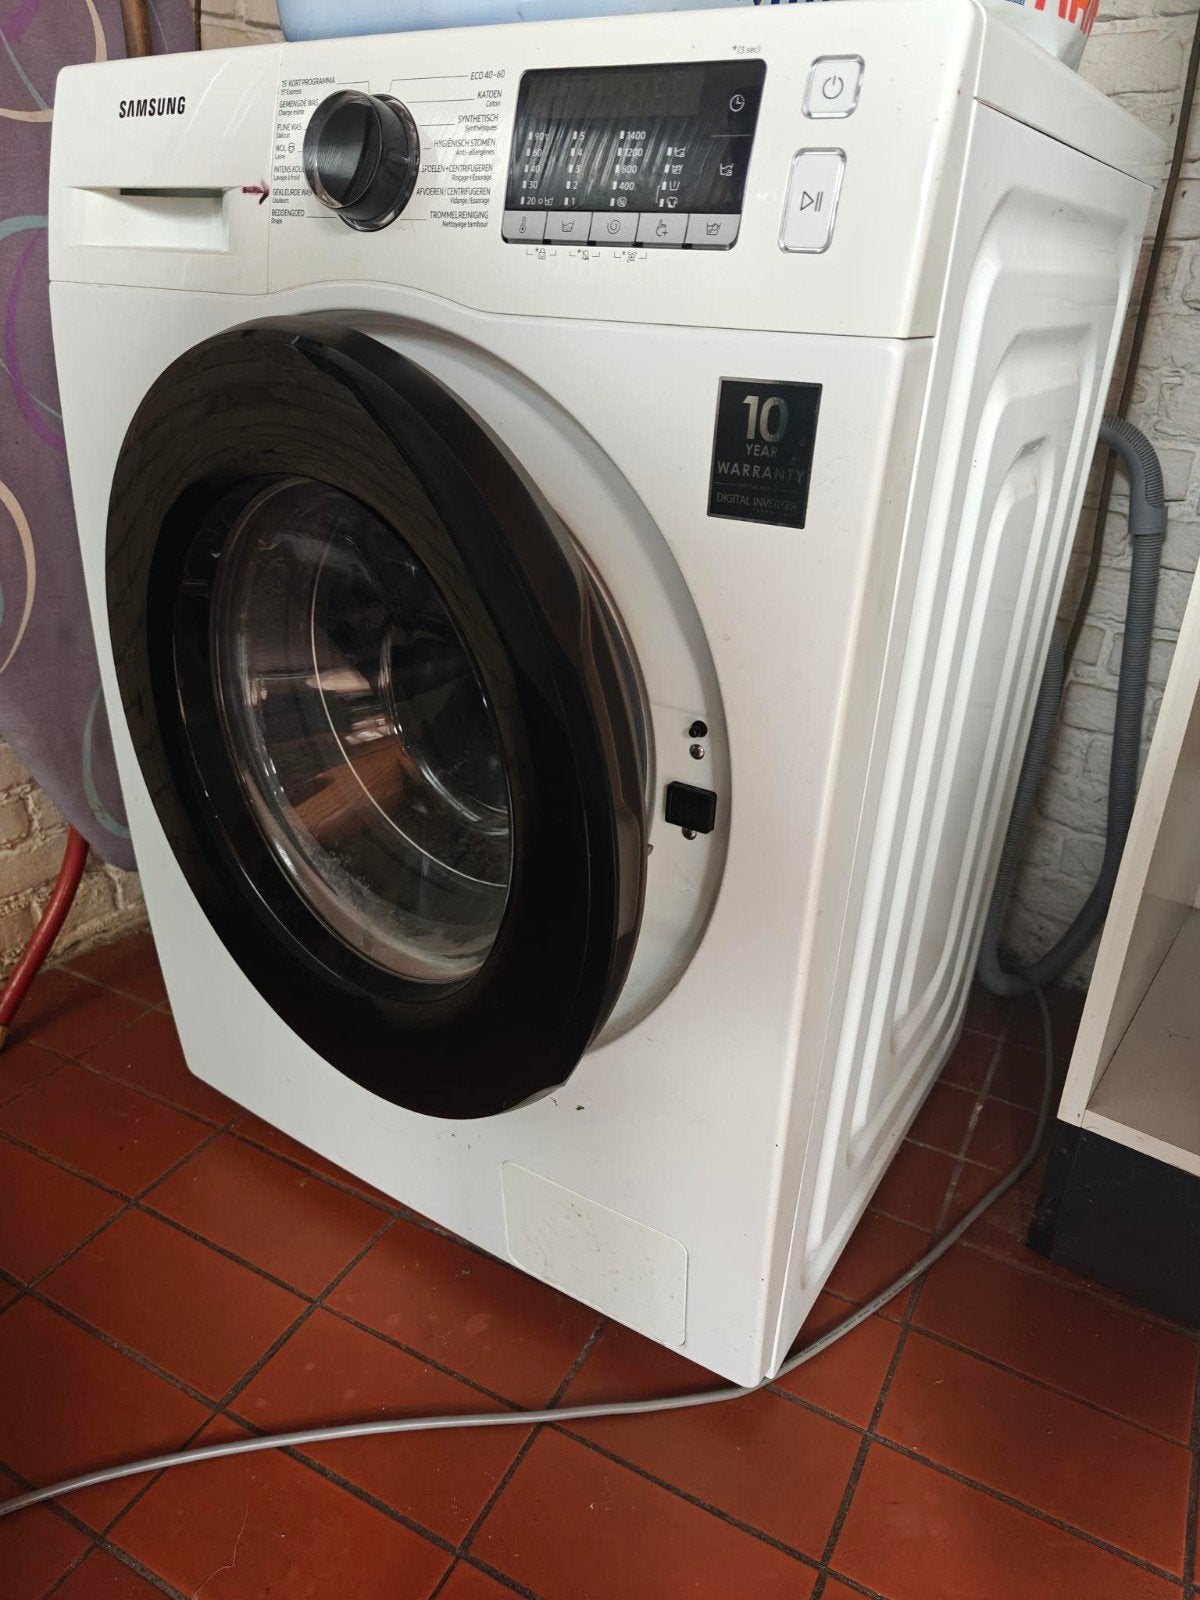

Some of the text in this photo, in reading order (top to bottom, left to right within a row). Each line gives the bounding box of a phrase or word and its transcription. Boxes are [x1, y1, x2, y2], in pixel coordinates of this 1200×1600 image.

[470, 71, 484, 81] ECO
[301, 77, 336, 86] PROGRAMMA
[477, 90, 502, 99] KATOEN
[119, 96, 186, 118] SAMSUNG
[279, 98, 319, 108] GEMENGDE WAS
[457, 114, 499, 124] SYNTHETISCH
[291, 123, 303, 131] WAS
[626, 130, 646, 140] 1400
[470, 139, 496, 147] STOMEN
[624, 147, 643, 157] 1200
[530, 164, 541, 173] 40
[621, 164, 638, 174] 800
[528, 180, 539, 189] 30
[619, 181, 635, 191] 400
[272, 188, 301, 197] GEKLEURDE
[416, 187, 445, 196] AFVOEREN
[446, 187, 492, 196] CENTRIFUGEREN
[526, 196, 536, 205] 20
[271, 209, 306, 217] BEDDENGOED
[430, 211, 489, 220] TROMMELREINIGING
[442, 221, 467, 230] Nettoyage
[742, 395, 789, 443] 10
[745, 443, 778, 458] YEAR
[717, 461, 805, 484] WARRANTY
[716, 493, 750, 506] DIGITAL
[753, 496, 799, 513] INVERTER
